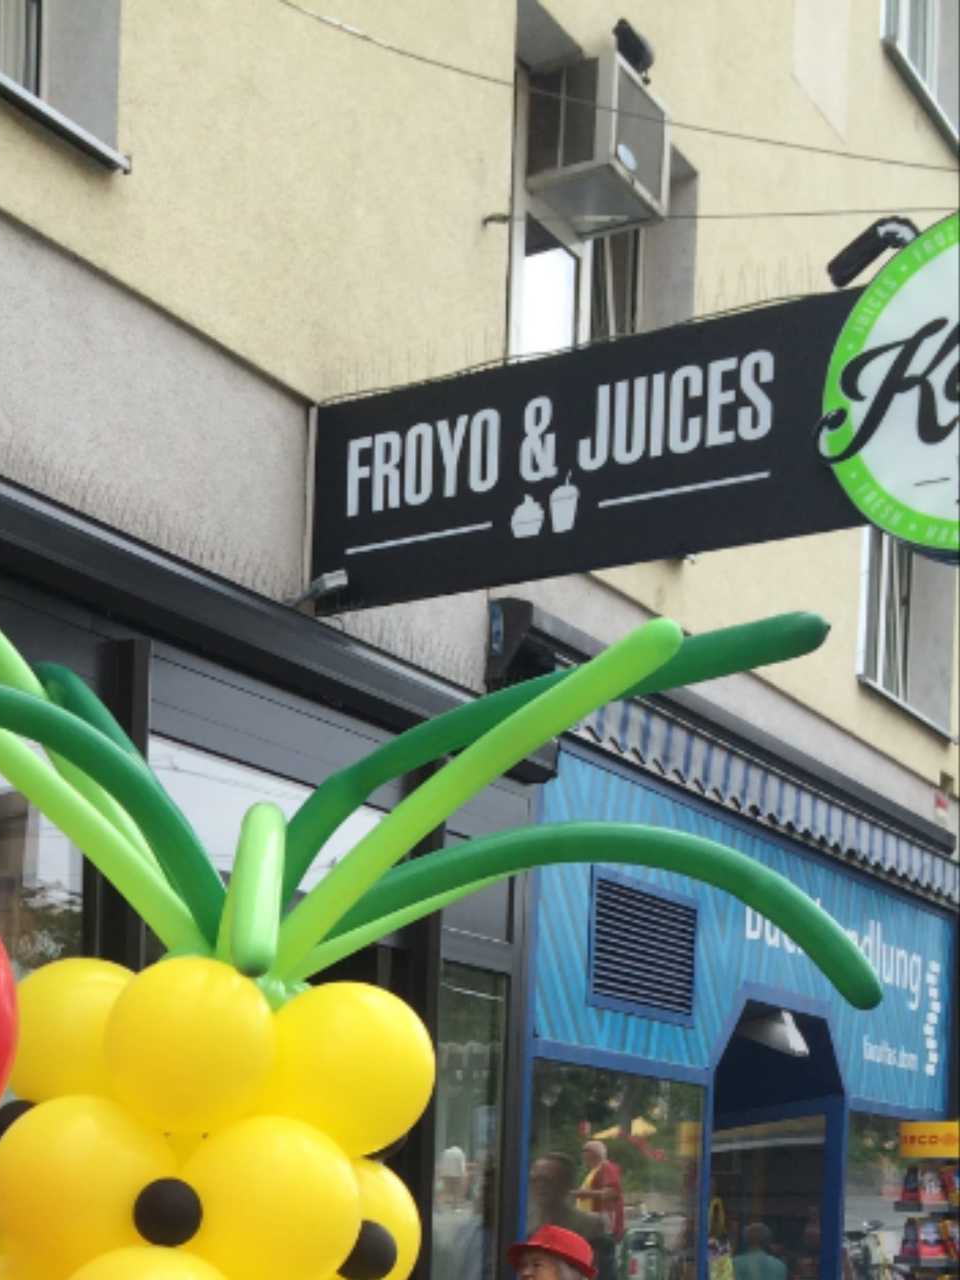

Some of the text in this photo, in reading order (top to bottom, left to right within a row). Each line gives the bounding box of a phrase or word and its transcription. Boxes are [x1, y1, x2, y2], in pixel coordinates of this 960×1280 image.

[346, 349, 775, 518] FROYO & JUICES
